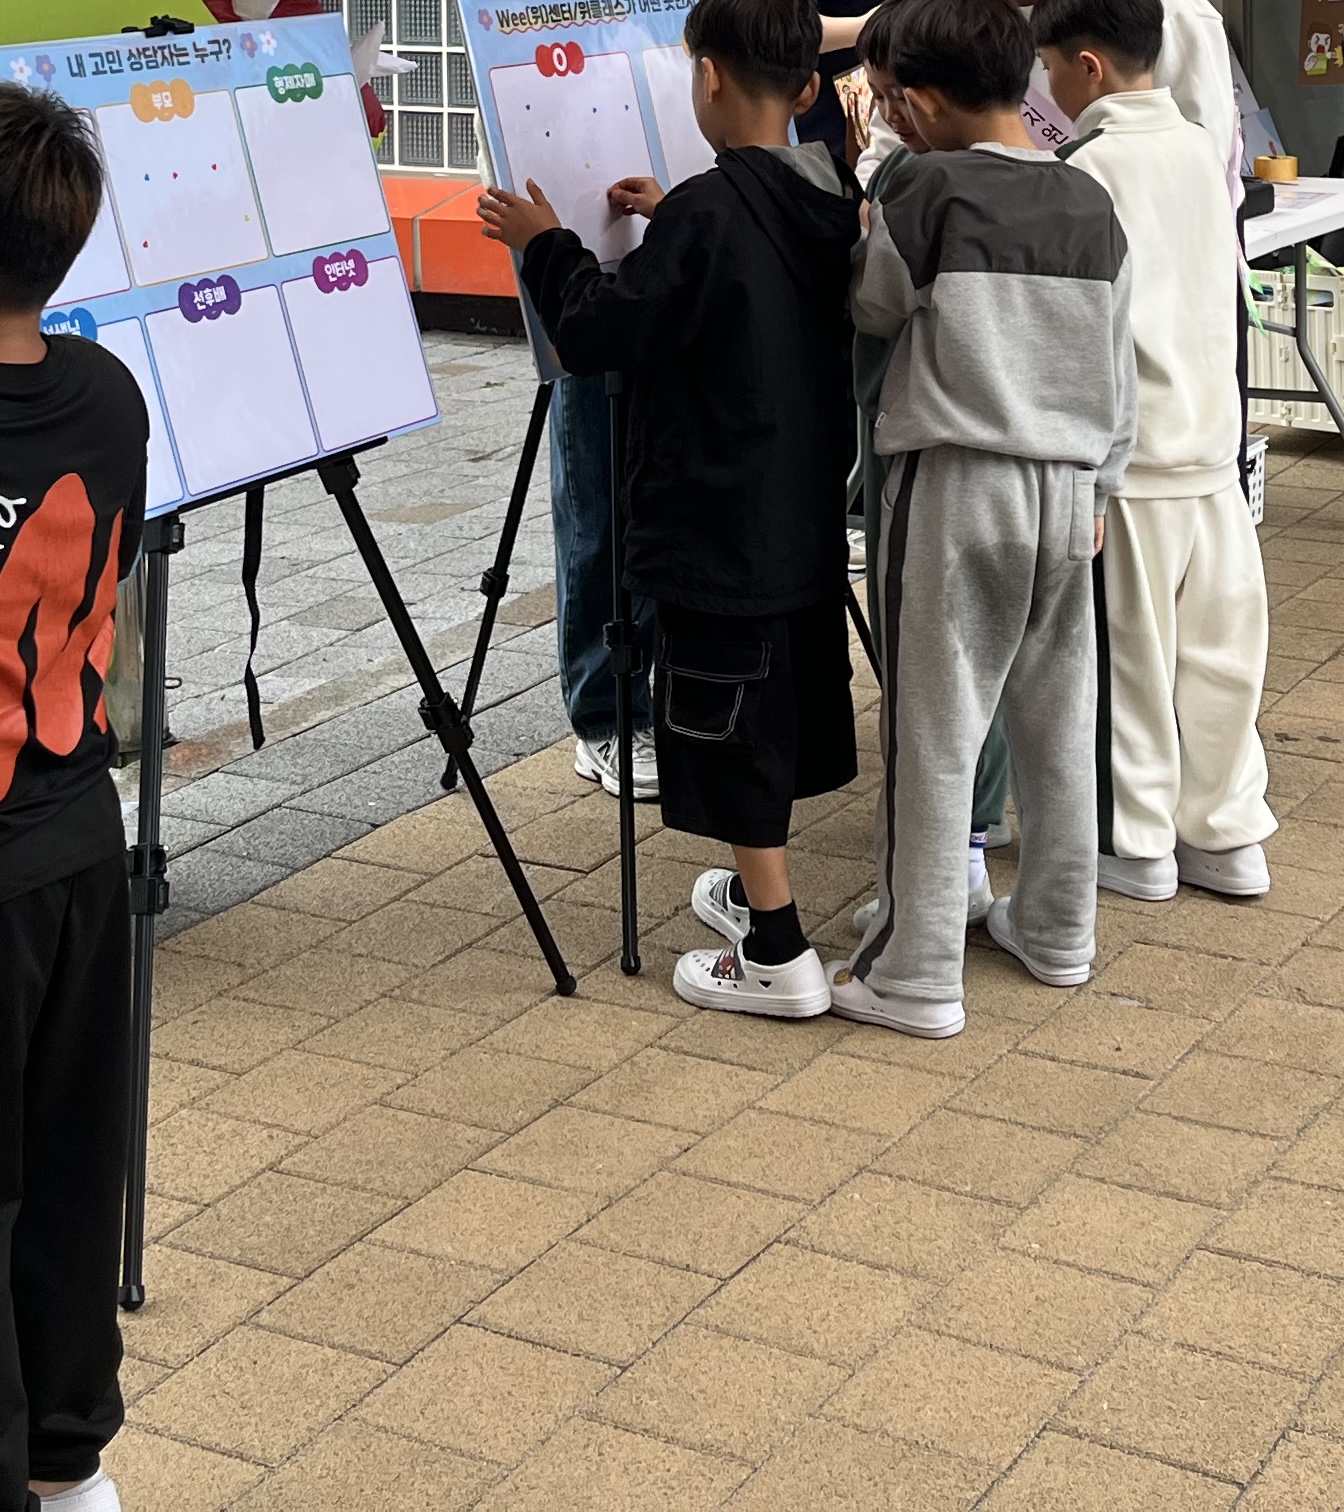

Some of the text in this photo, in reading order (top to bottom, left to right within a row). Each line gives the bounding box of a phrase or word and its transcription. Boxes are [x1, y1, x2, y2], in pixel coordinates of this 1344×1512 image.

[67, 38, 233, 79] 내 고민 상담자는 누구?
[272, 71, 317, 94] 형제자매
[151, 91, 174, 111] 부모
[324, 260, 357, 282] 인터넷
[193, 284, 227, 309] 선후배
